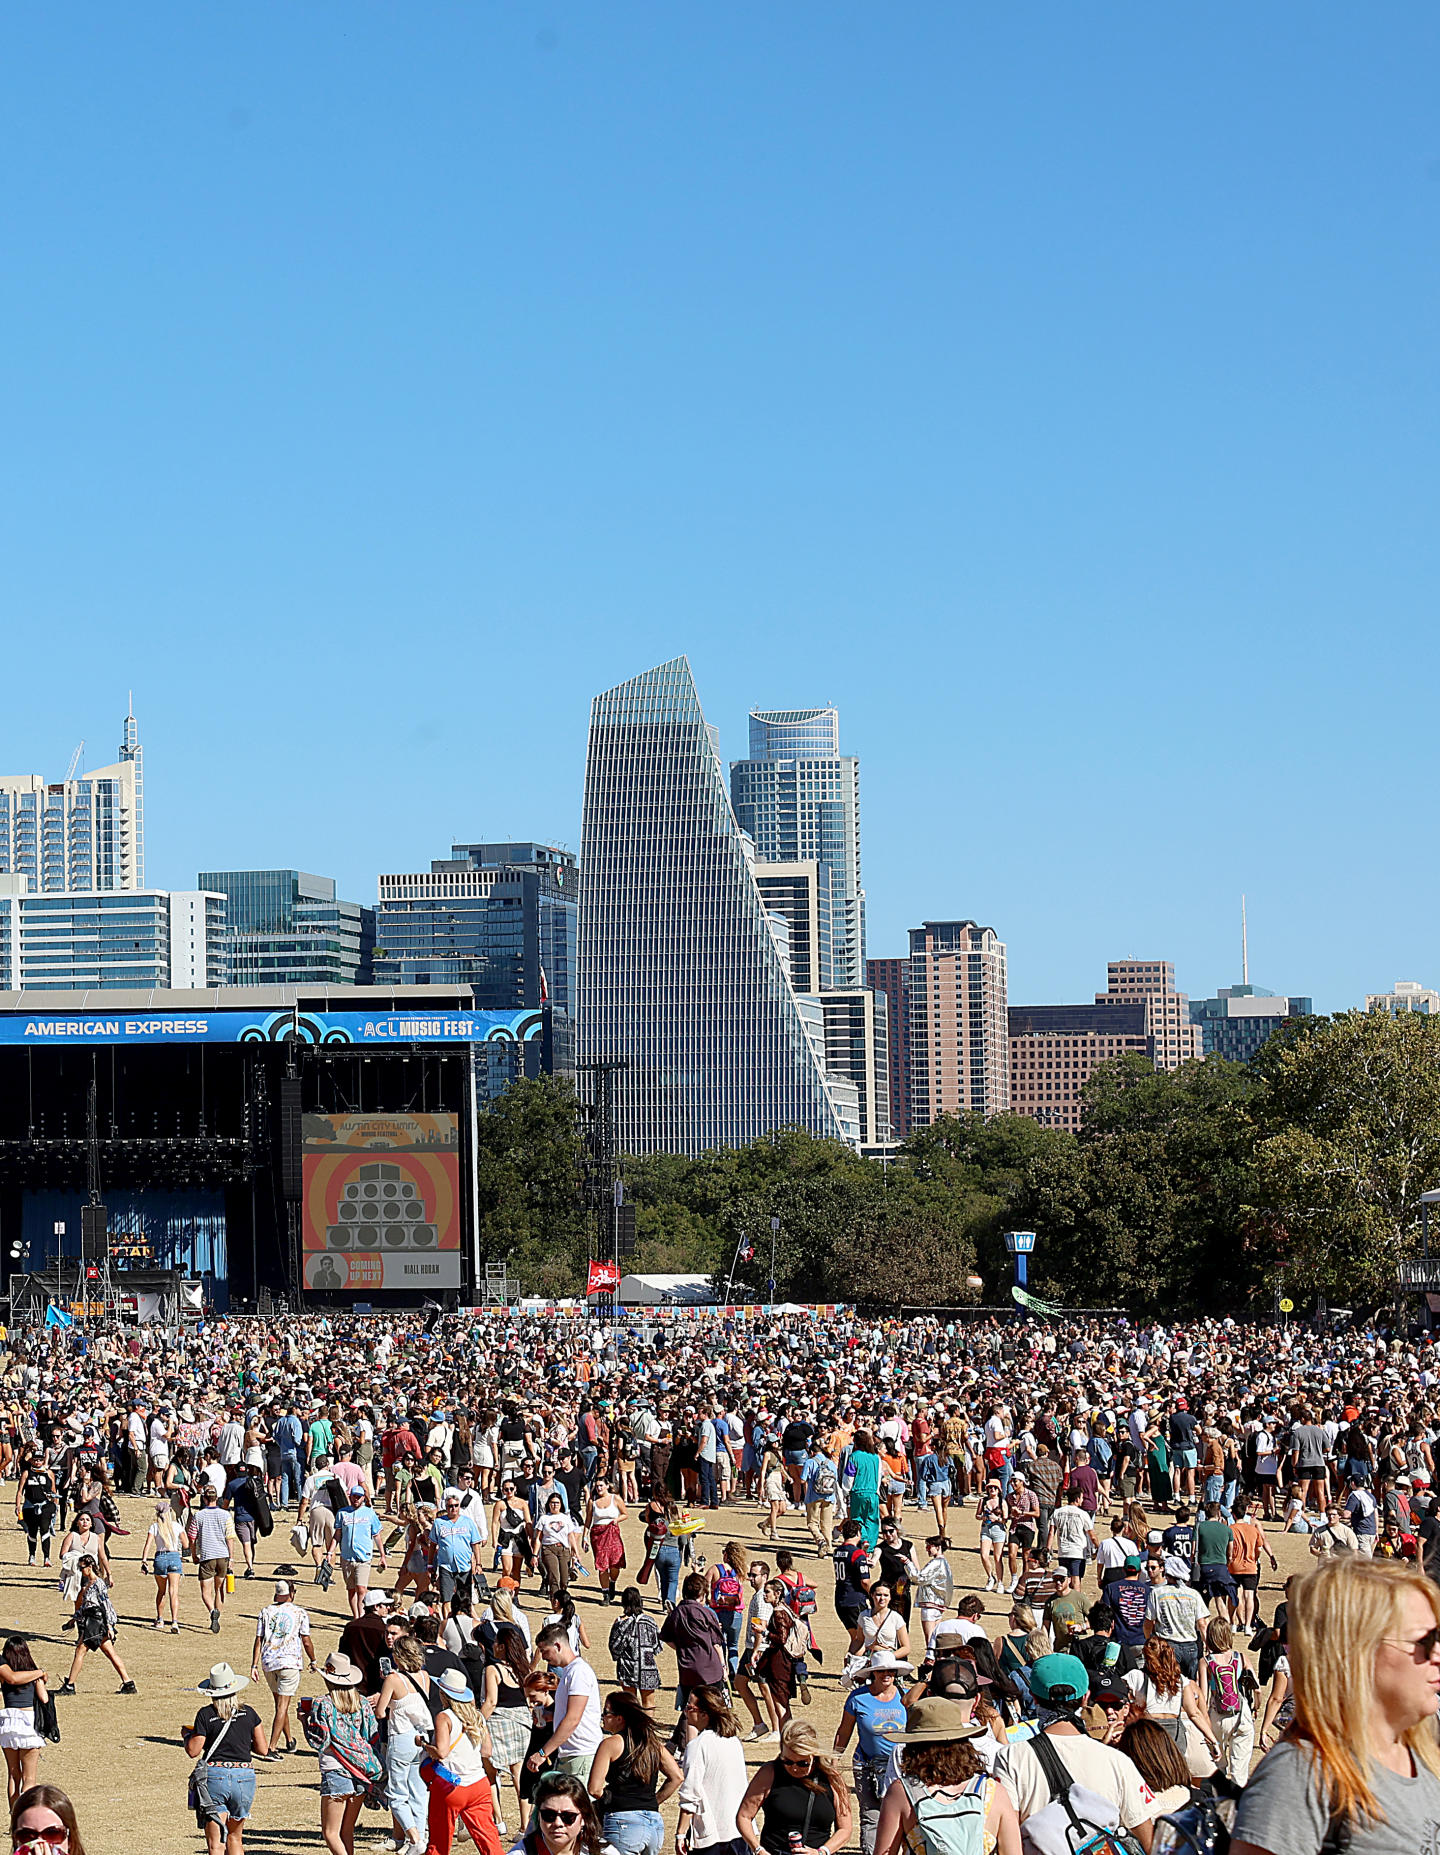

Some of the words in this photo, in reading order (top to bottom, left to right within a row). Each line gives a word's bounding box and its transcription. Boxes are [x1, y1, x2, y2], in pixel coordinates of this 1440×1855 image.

[24, 1022, 119, 1036] AMERICAN
[125, 1020, 208, 1034] EXPRESS
[364, 1021, 398, 1037] ACL
[400, 1021, 441, 1036] MUSIC
[444, 1020, 474, 1036] FEST
[350, 1261, 381, 1270] COMING
[404, 1264, 419, 1275] NIALL
[350, 1271, 361, 1281] UP
[362, 1270, 382, 1281] NEXT
[1412, 1456, 1418, 1469] 3
[1173, 1540, 1192, 1558] 30
